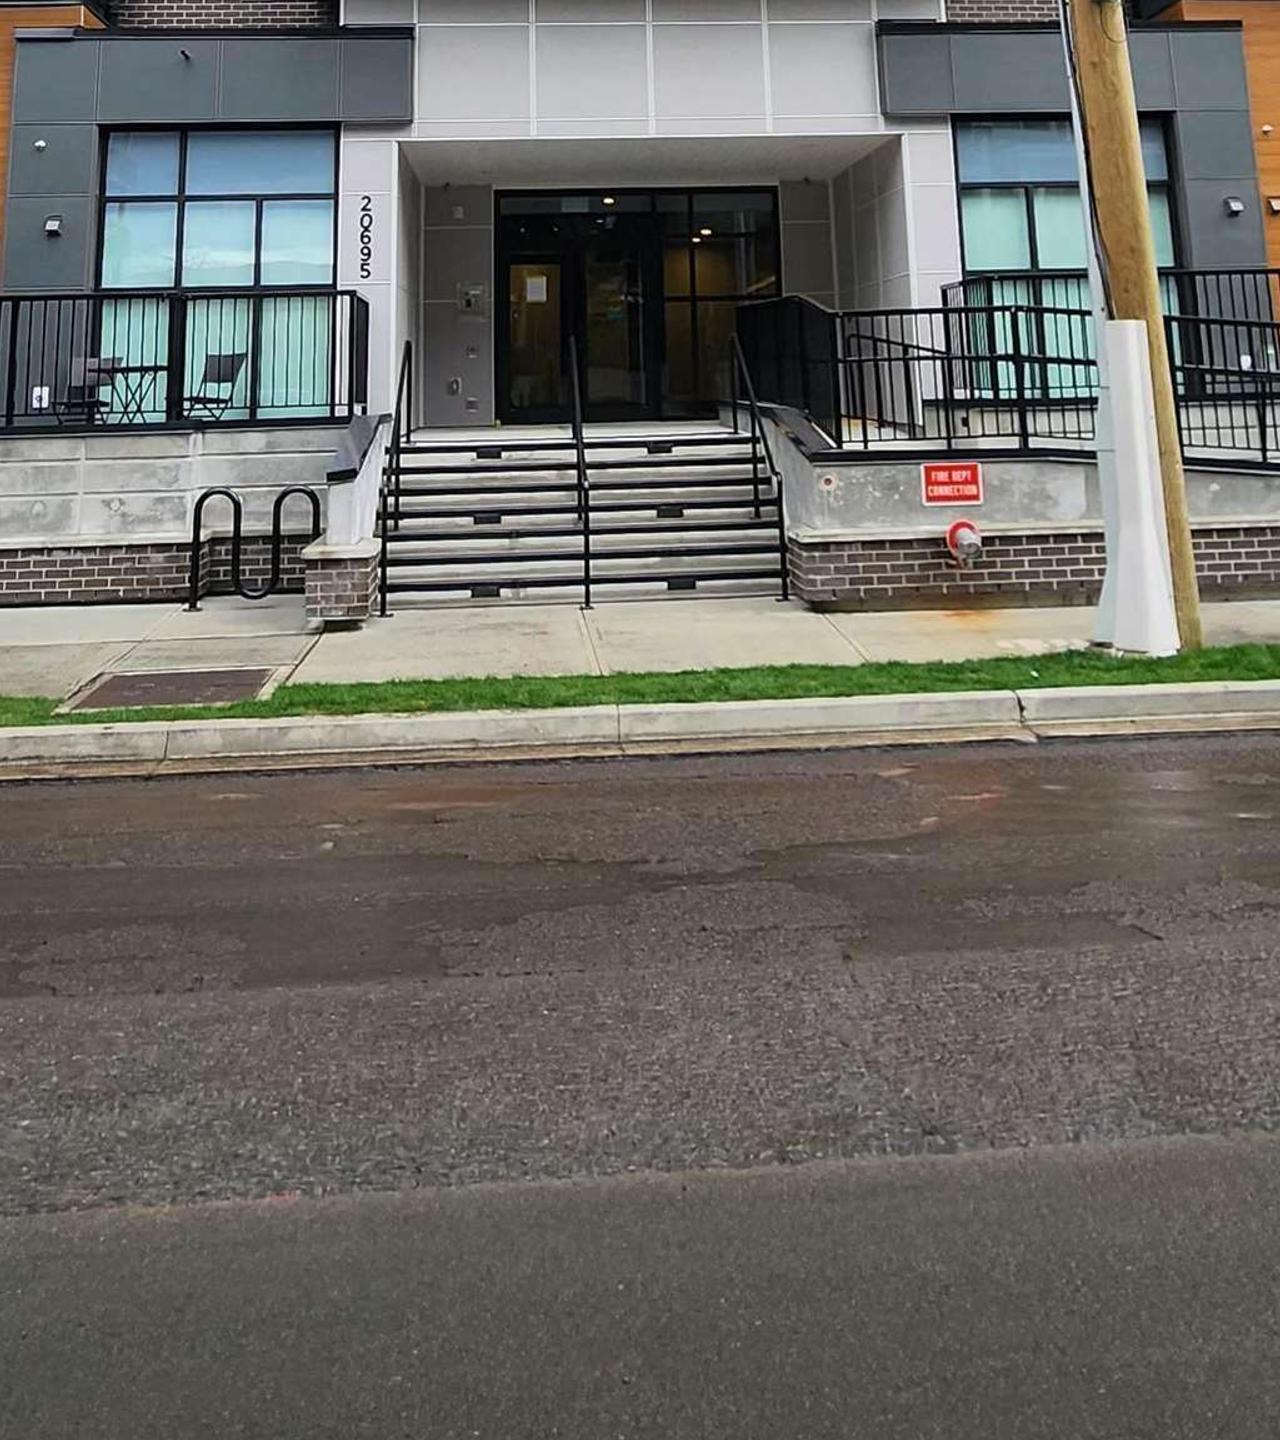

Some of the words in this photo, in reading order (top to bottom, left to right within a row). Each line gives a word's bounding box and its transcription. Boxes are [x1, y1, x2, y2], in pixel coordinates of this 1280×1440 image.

[360, 195, 373, 279] 20695
[931, 471, 949, 482] FIRE
[951, 470, 972, 482] DEPT
[927, 484, 978, 497] CONNECTION
